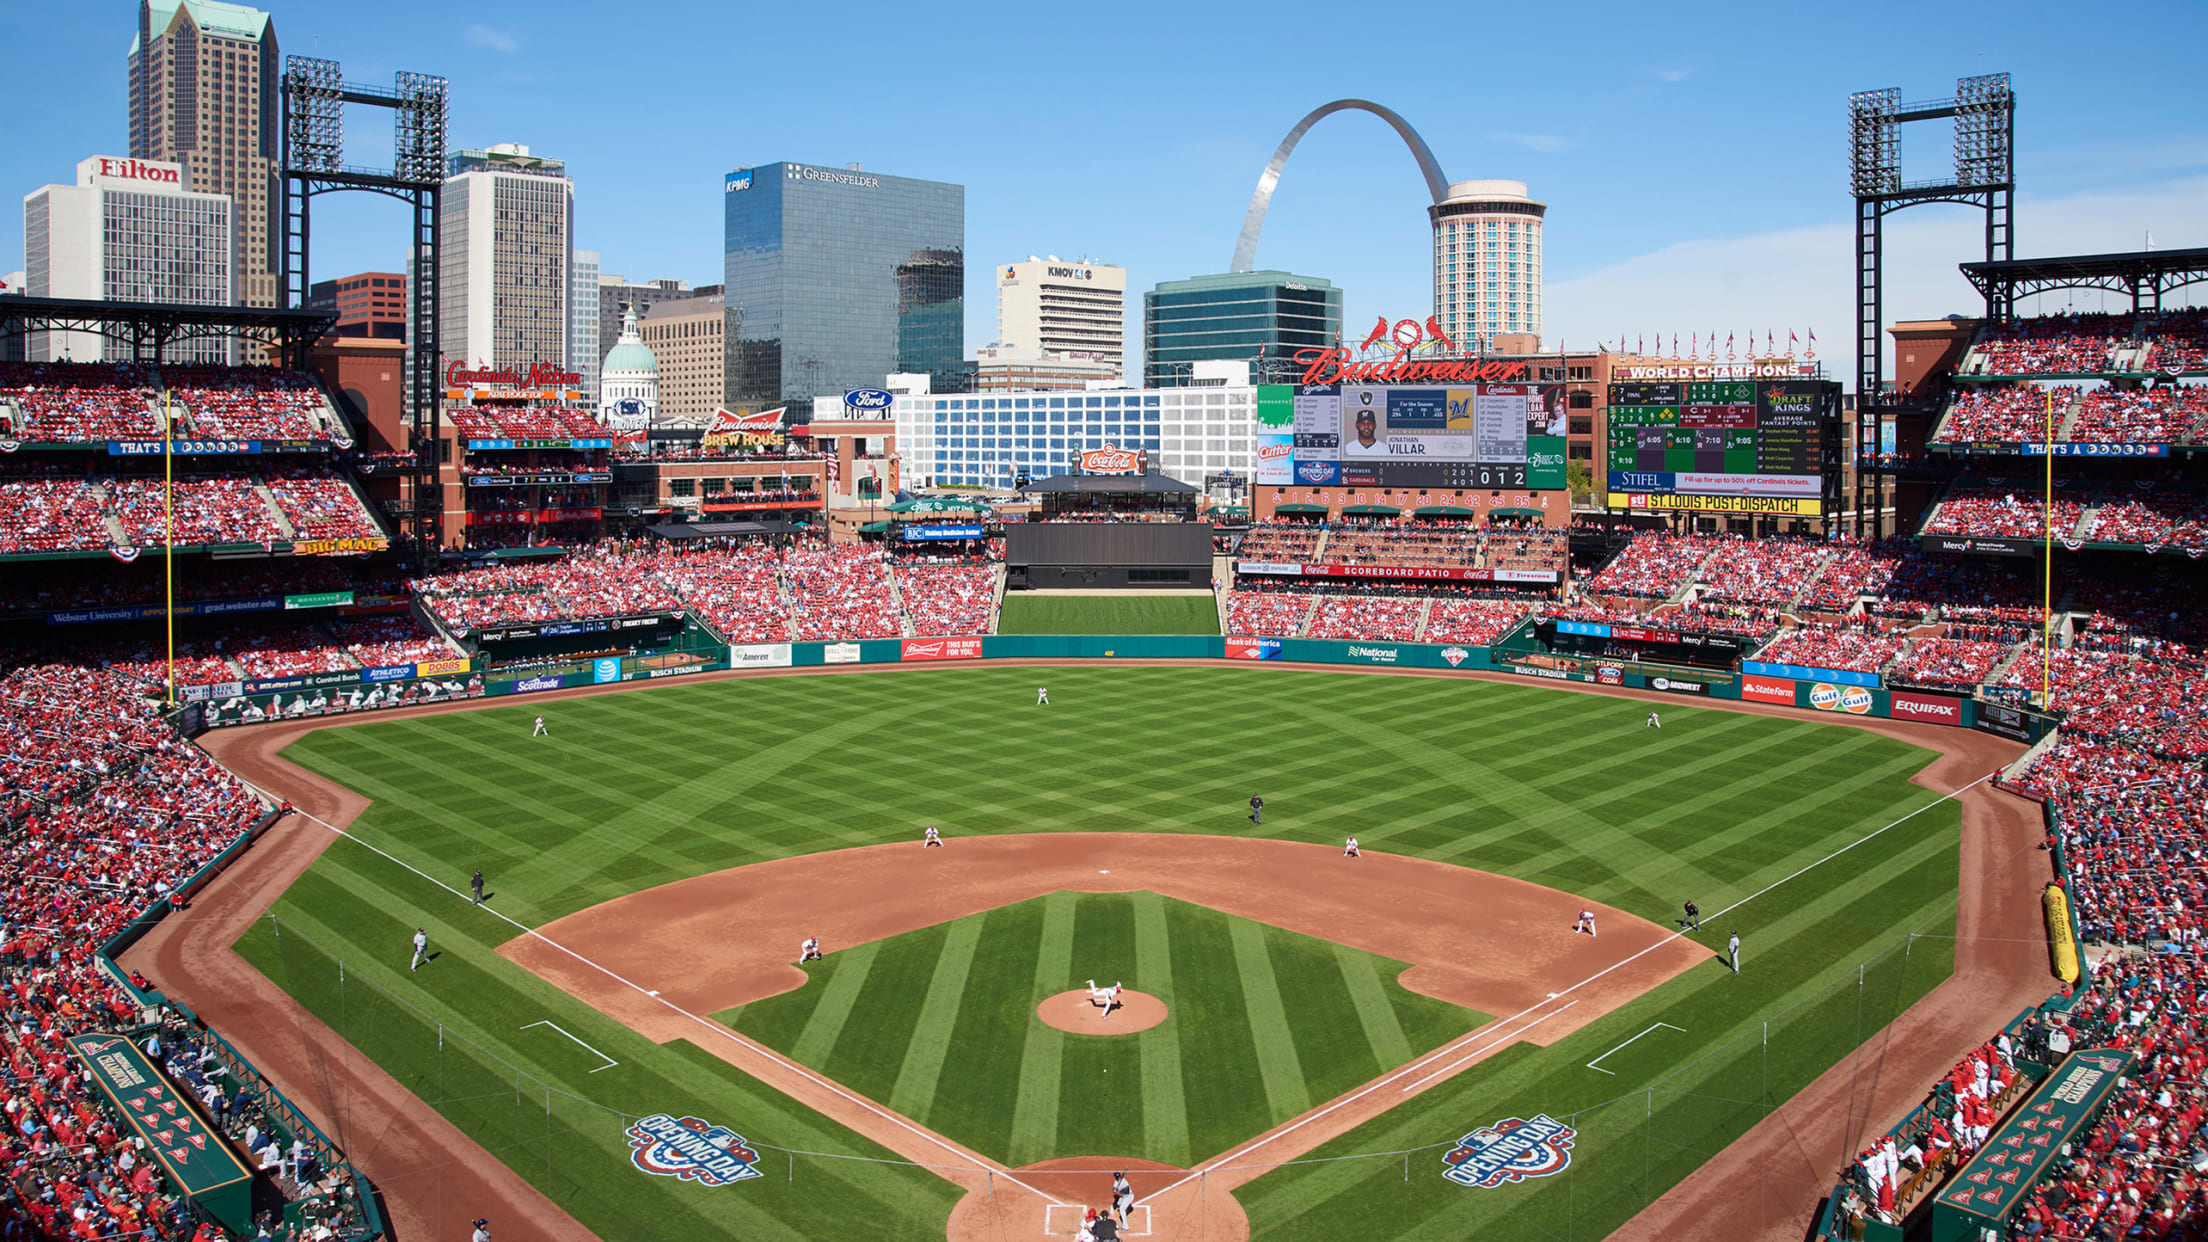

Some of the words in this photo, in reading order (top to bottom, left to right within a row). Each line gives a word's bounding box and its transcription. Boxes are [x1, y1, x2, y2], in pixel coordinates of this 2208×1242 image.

[100, 158, 179, 183] Hilton
[803, 167, 880, 188] GREENSFELDER
[726, 178, 750, 193] KPMG
[1048, 266, 1073, 278] KMOV
[1293, 348, 1526, 385] Budweiser
[1629, 366, 1690, 379] WORLD
[1693, 365, 1800, 379] CHAMPIONS
[446, 360, 520, 388] Cardinals
[520, 362, 581, 389] Nation
[1527, 386, 1539, 394] THE
[855, 391, 886, 406] Ford
[1771, 395, 1812, 404] DRAFT
[620, 401, 640, 415] FOX
[1527, 403, 1544, 412] LOAN
[1775, 404, 1811, 412] KINGS
[704, 413, 784, 432] Budweiser
[1527, 412, 1549, 421] EXPERT
[703, 434, 740, 446] BREW
[742, 434, 785, 446] HOUSE
[120, 443, 160, 453] THAT'S
[1258, 444, 1293, 459] Cutter
[1388, 444, 1426, 454] VILLAR
[2029, 444, 2067, 455] THAT'S
[2073, 444, 2081, 454] A
[1088, 453, 1131, 469] Coca-Cola
[1481, 472, 1489, 484] 0
[1498, 472, 1504, 484] 1
[1515, 472, 1524, 485] 2
[1622, 472, 1660, 486] STIFEL
[1292, 492, 1297, 504] 1
[1305, 492, 1313, 504] 2
[1321, 493, 1329, 504] 6
[1337, 493, 1345, 504] 9
[1355, 493, 1365, 505] 10
[1375, 494, 1386, 505] 14
[1396, 494, 1408, 506] 17
[1416, 495, 1431, 506] 20
[1440, 495, 1455, 506] 24
[1465, 495, 1480, 507] 42
[1489, 495, 1504, 507] 45
[1514, 496, 1529, 507] 85
[1631, 494, 1646, 504] stl
[1651, 495, 1667, 508] ST.
[1669, 496, 1701, 508] LOUIS
[1705, 497, 1799, 512] POST-DISPATCH
[907, 528, 922, 537] BJC
[305, 540, 335, 554] BIG
[340, 539, 379, 552] MAC
[1943, 541, 1966, 551] Mercy
[1304, 565, 1330, 575] Coca-Cola
[1344, 567, 1414, 577] SCOREBOARD
[1418, 569, 1450, 578] PATIO
[1463, 570, 1489, 580] Coca-Cola
[54, 612, 87, 622] Webster
[89, 610, 132, 621] University
[142, 608, 167, 616] APPLY
[205, 601, 276, 613] grad.webster.edu
[482, 633, 503, 641] Mercy
[1227, 637, 1243, 645] Bank
[1244, 638, 1252, 646] of
[1252, 638, 1280, 648] America
[1682, 636, 1701, 645] Mercy
[961, 640, 980, 648] BUD'S
[743, 653, 769, 661] Ameren
[960, 648, 974, 656] YOU.
[1359, 648, 1398, 657] National
[428, 661, 460, 671] DOBBS
[1595, 661, 1624, 669] STLFORD
[369, 667, 409, 677] ATHLETICO
[650, 669, 672, 678] BUSCH
[673, 666, 703, 675] STADIUM
[1515, 666, 1537, 675] BUSCH
[1537, 669, 1567, 679] STADIUM
[315, 675, 341, 684] Central
[342, 673, 360, 682] Bank
[517, 677, 559, 691] Scottrade
[1669, 681, 1701, 692] MIDWEST
[1811, 692, 1837, 703] Gulf
[1842, 695, 1869, 707] Gulf
[1895, 700, 1954, 716] EQUIFAX
[2063, 1069, 2104, 1104] CHAMPIONS
[638, 1116, 721, 1161] OPENING
[705, 1156, 757, 1181] DAY
[1447, 1135, 1534, 1185] OPENING
[1516, 1116, 1563, 1141] DAY
